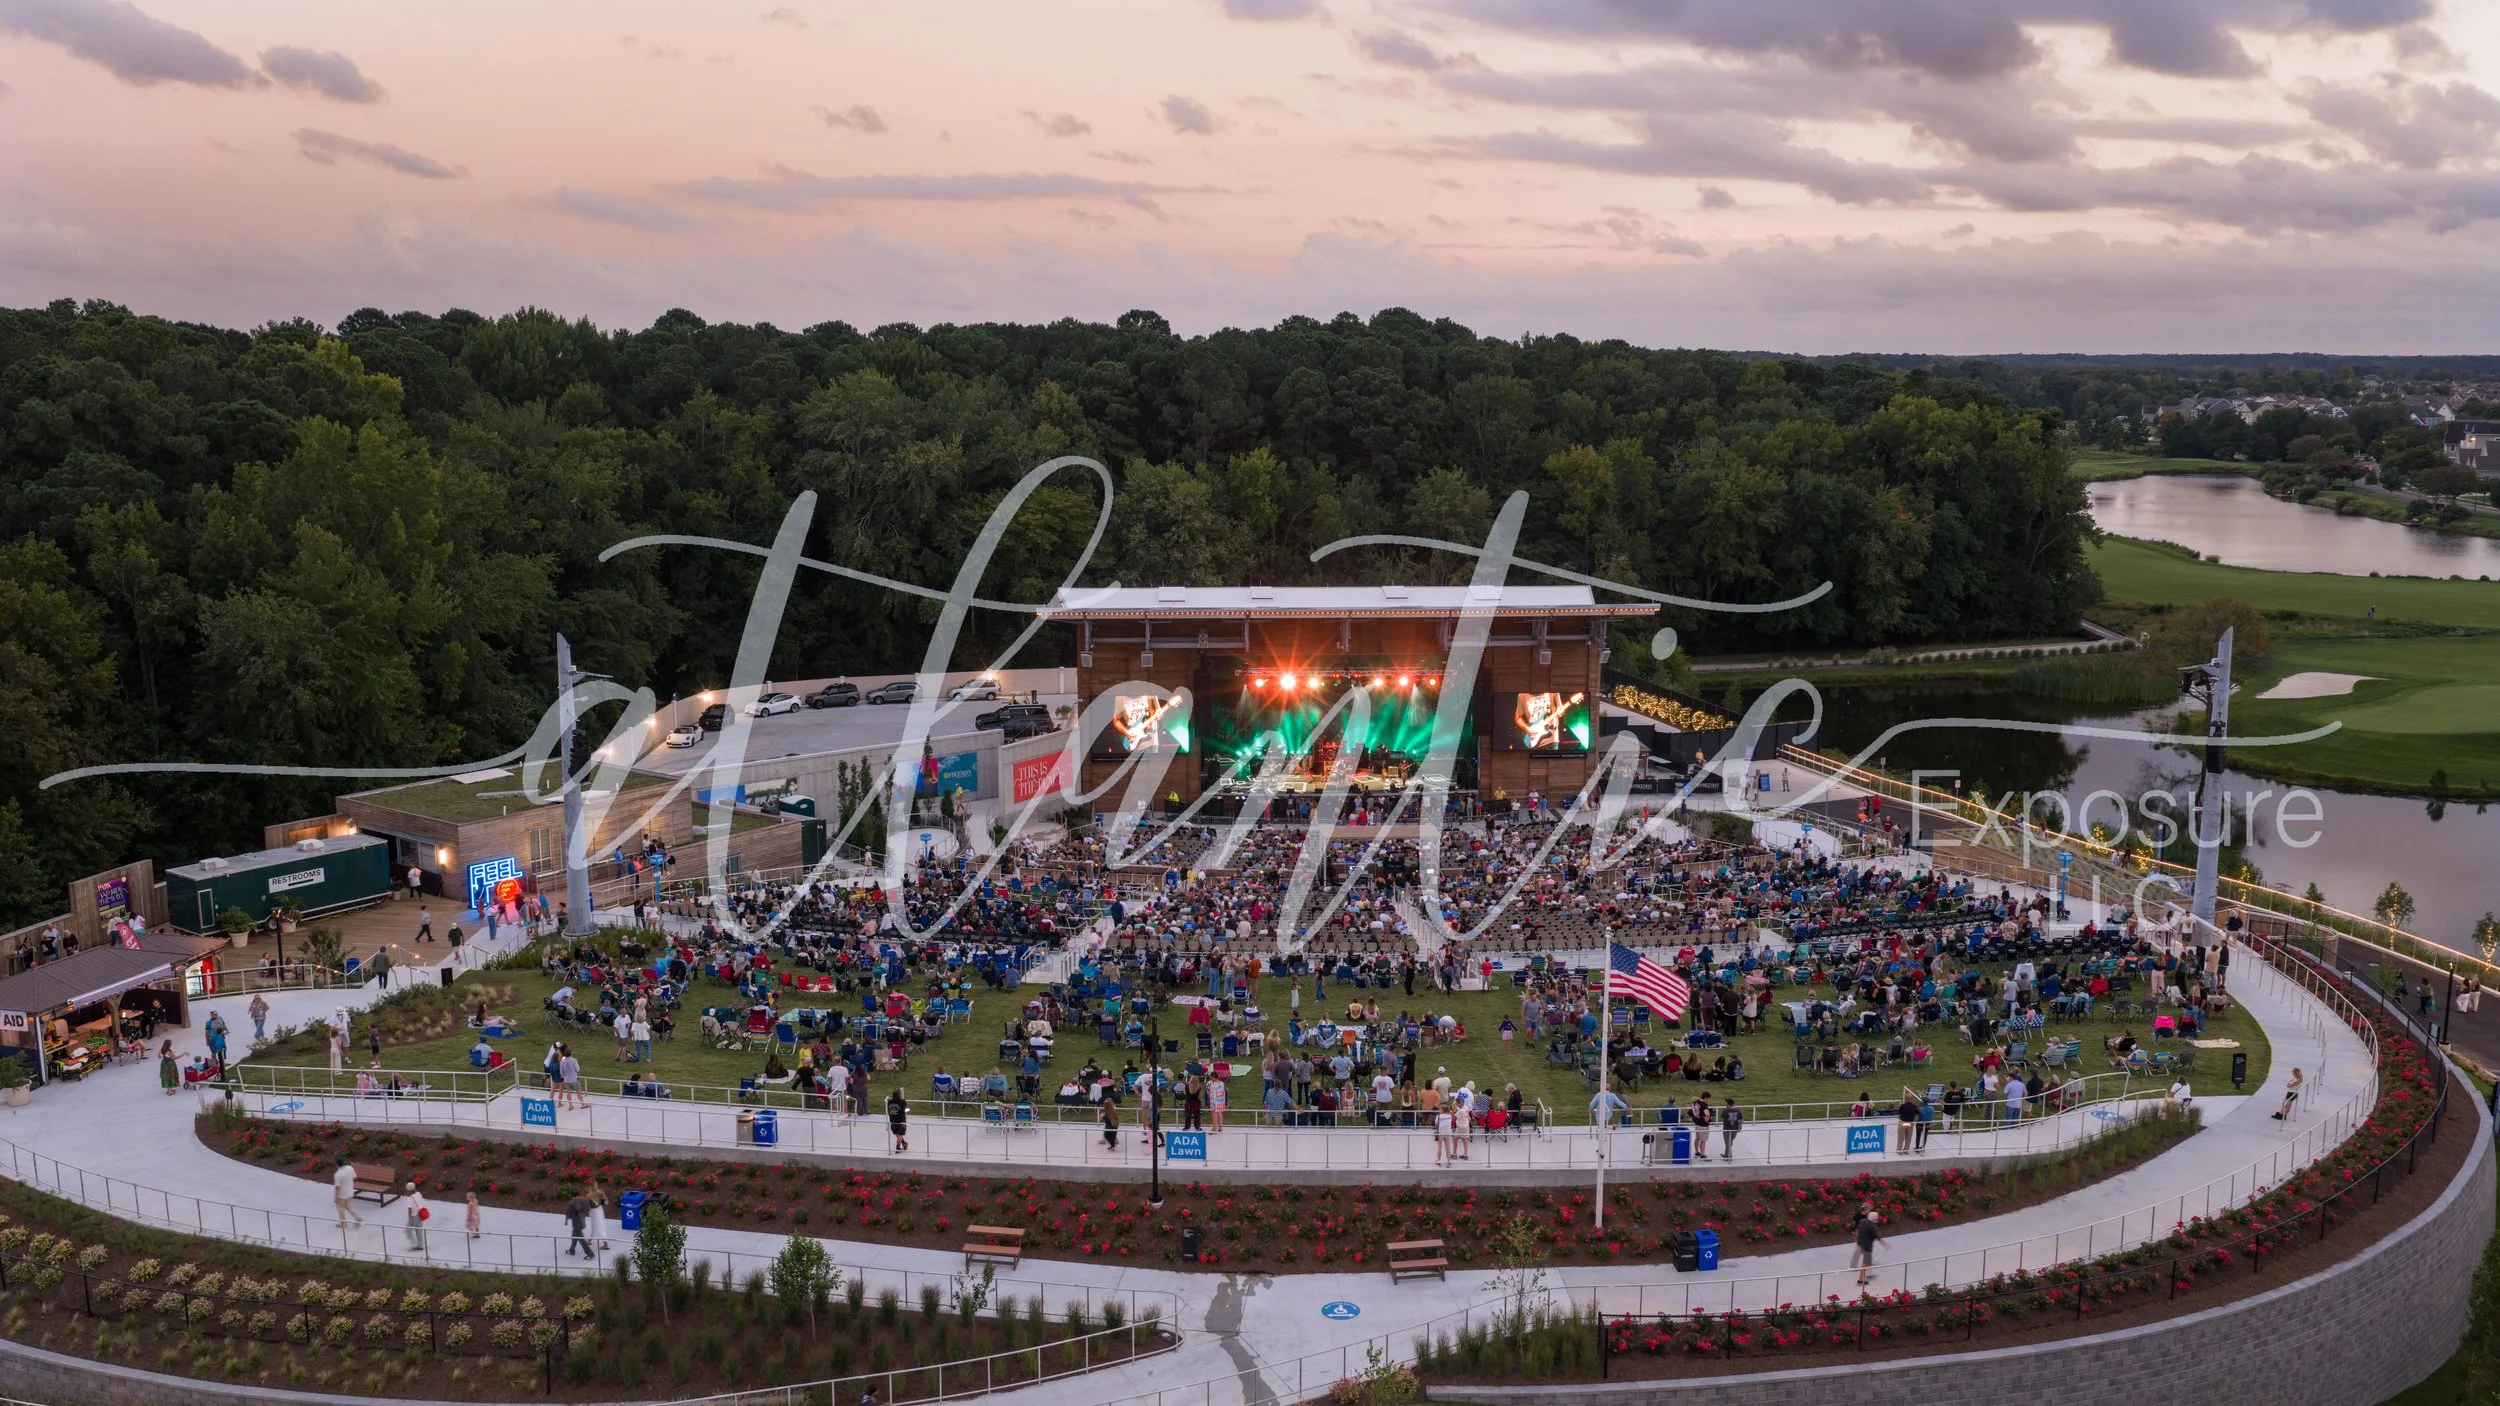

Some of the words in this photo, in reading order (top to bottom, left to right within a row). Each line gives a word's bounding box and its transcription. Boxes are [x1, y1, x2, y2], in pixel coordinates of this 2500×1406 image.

[1018, 763, 1039, 782] THIS
[1040, 760, 1048, 779] IS
[1017, 778, 1037, 797] THE
[272, 869, 321, 885] RESTROOMS
[470, 857, 523, 888] FEEL
[3, 1013, 25, 1027] AID
[527, 1102, 549, 1113] ADA
[525, 1112, 552, 1123] Lawn
[1853, 1129, 1878, 1140] ADA
[1173, 1136, 1199, 1146] ADA
[1851, 1141, 1880, 1150] Lawn
[1171, 1146, 1202, 1156] Lawn
